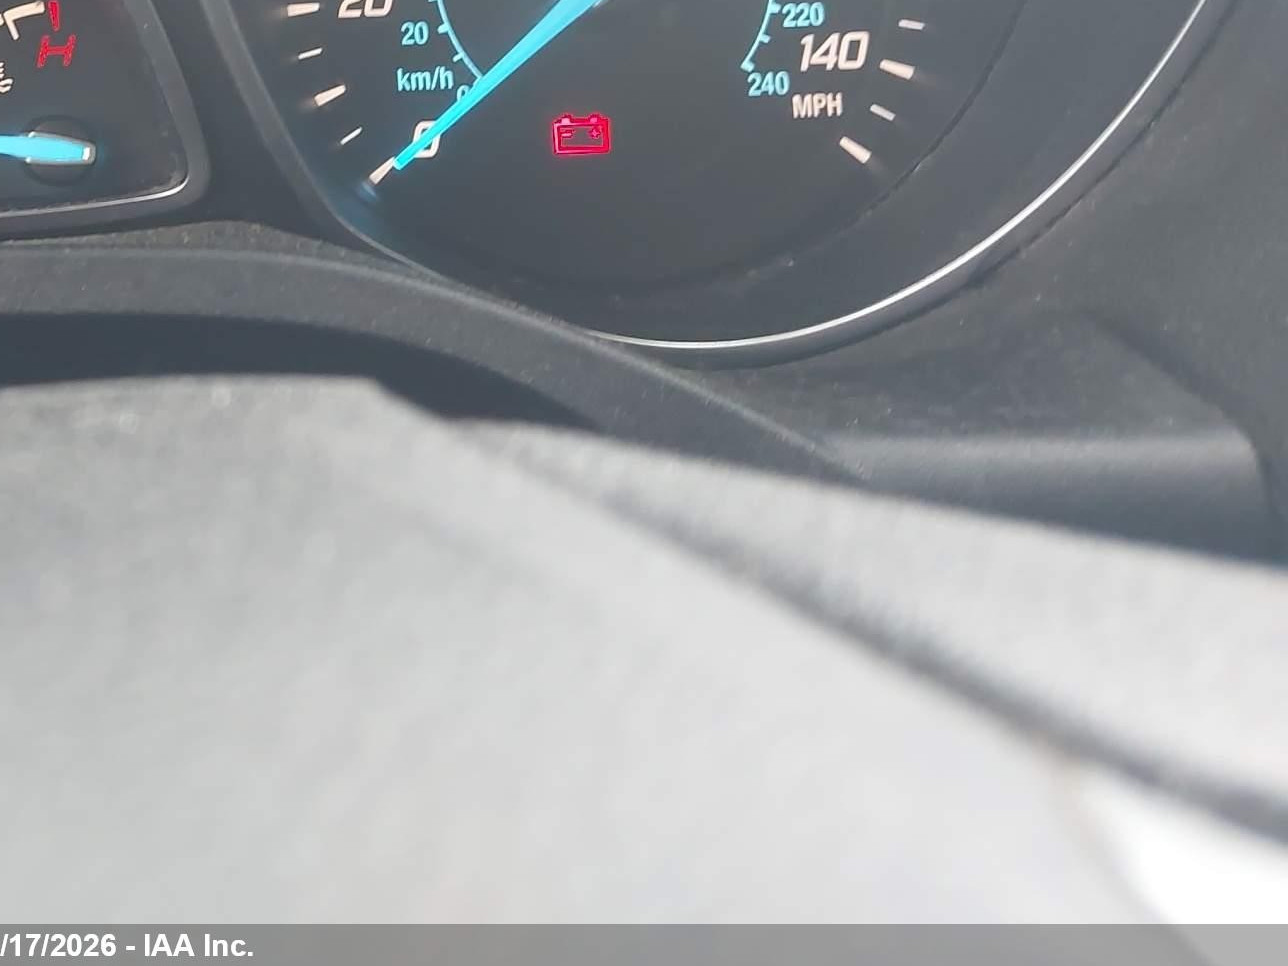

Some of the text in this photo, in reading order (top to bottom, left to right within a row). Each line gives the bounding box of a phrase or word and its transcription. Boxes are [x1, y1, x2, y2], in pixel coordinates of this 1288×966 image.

[782, 2, 826, 28] 220
[401, 21, 430, 46] 20
[36, 34, 77, 68] H
[799, 31, 870, 73] 140
[396, 65, 455, 92] km/h
[747, 70, 790, 98] 240
[791, 94, 844, 119] MPH
